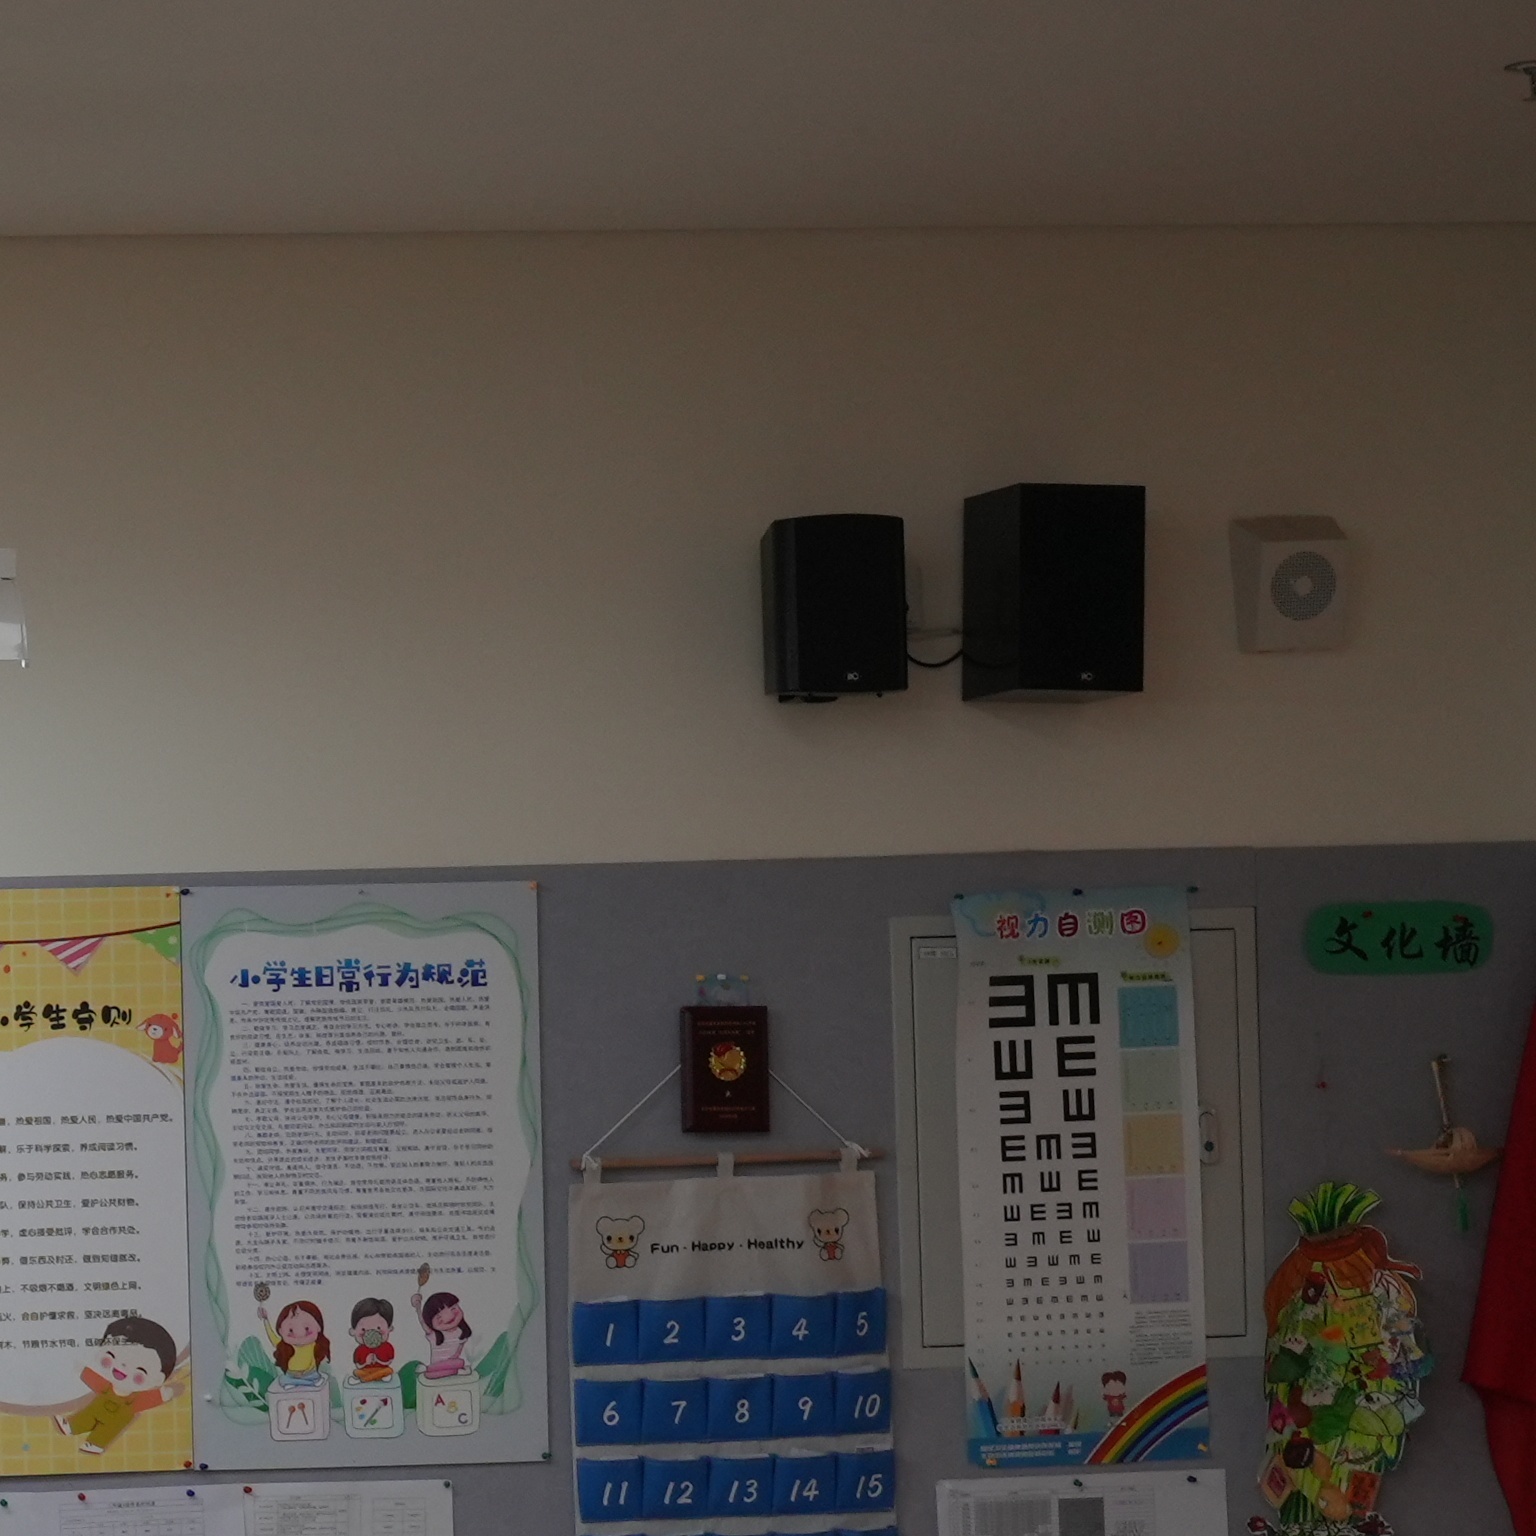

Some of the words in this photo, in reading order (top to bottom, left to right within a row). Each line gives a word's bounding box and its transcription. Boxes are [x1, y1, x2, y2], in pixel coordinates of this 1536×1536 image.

[996, 908, 1147, 940] 视力自测图
[1324, 916, 1480, 967] 文化墙
[230, 958, 488, 993] 小学生日常行为规范
[650, 1243, 679, 1254] Fun
[691, 1240, 735, 1251] Happy
[747, 1238, 804, 1250] Healthy
[606, 1324, 615, 1346] 1
[665, 1321, 679, 1344] 2
[731, 1317, 746, 1341] 3
[793, 1318, 808, 1340] 4
[856, 1312, 868, 1336] 5
[434, 1394, 446, 1407] A
[458, 1413, 468, 1424] C
[604, 1401, 620, 1426] 6
[671, 1400, 687, 1424] 7
[735, 1399, 749, 1422] 8
[799, 1397, 812, 1420] 9
[854, 1395, 880, 1418] 10
[604, 1481, 628, 1506] 11
[664, 1481, 693, 1504] 12
[729, 1479, 757, 1502] 13
[791, 1479, 819, 1501] 14
[856, 1474, 882, 1499] 15
